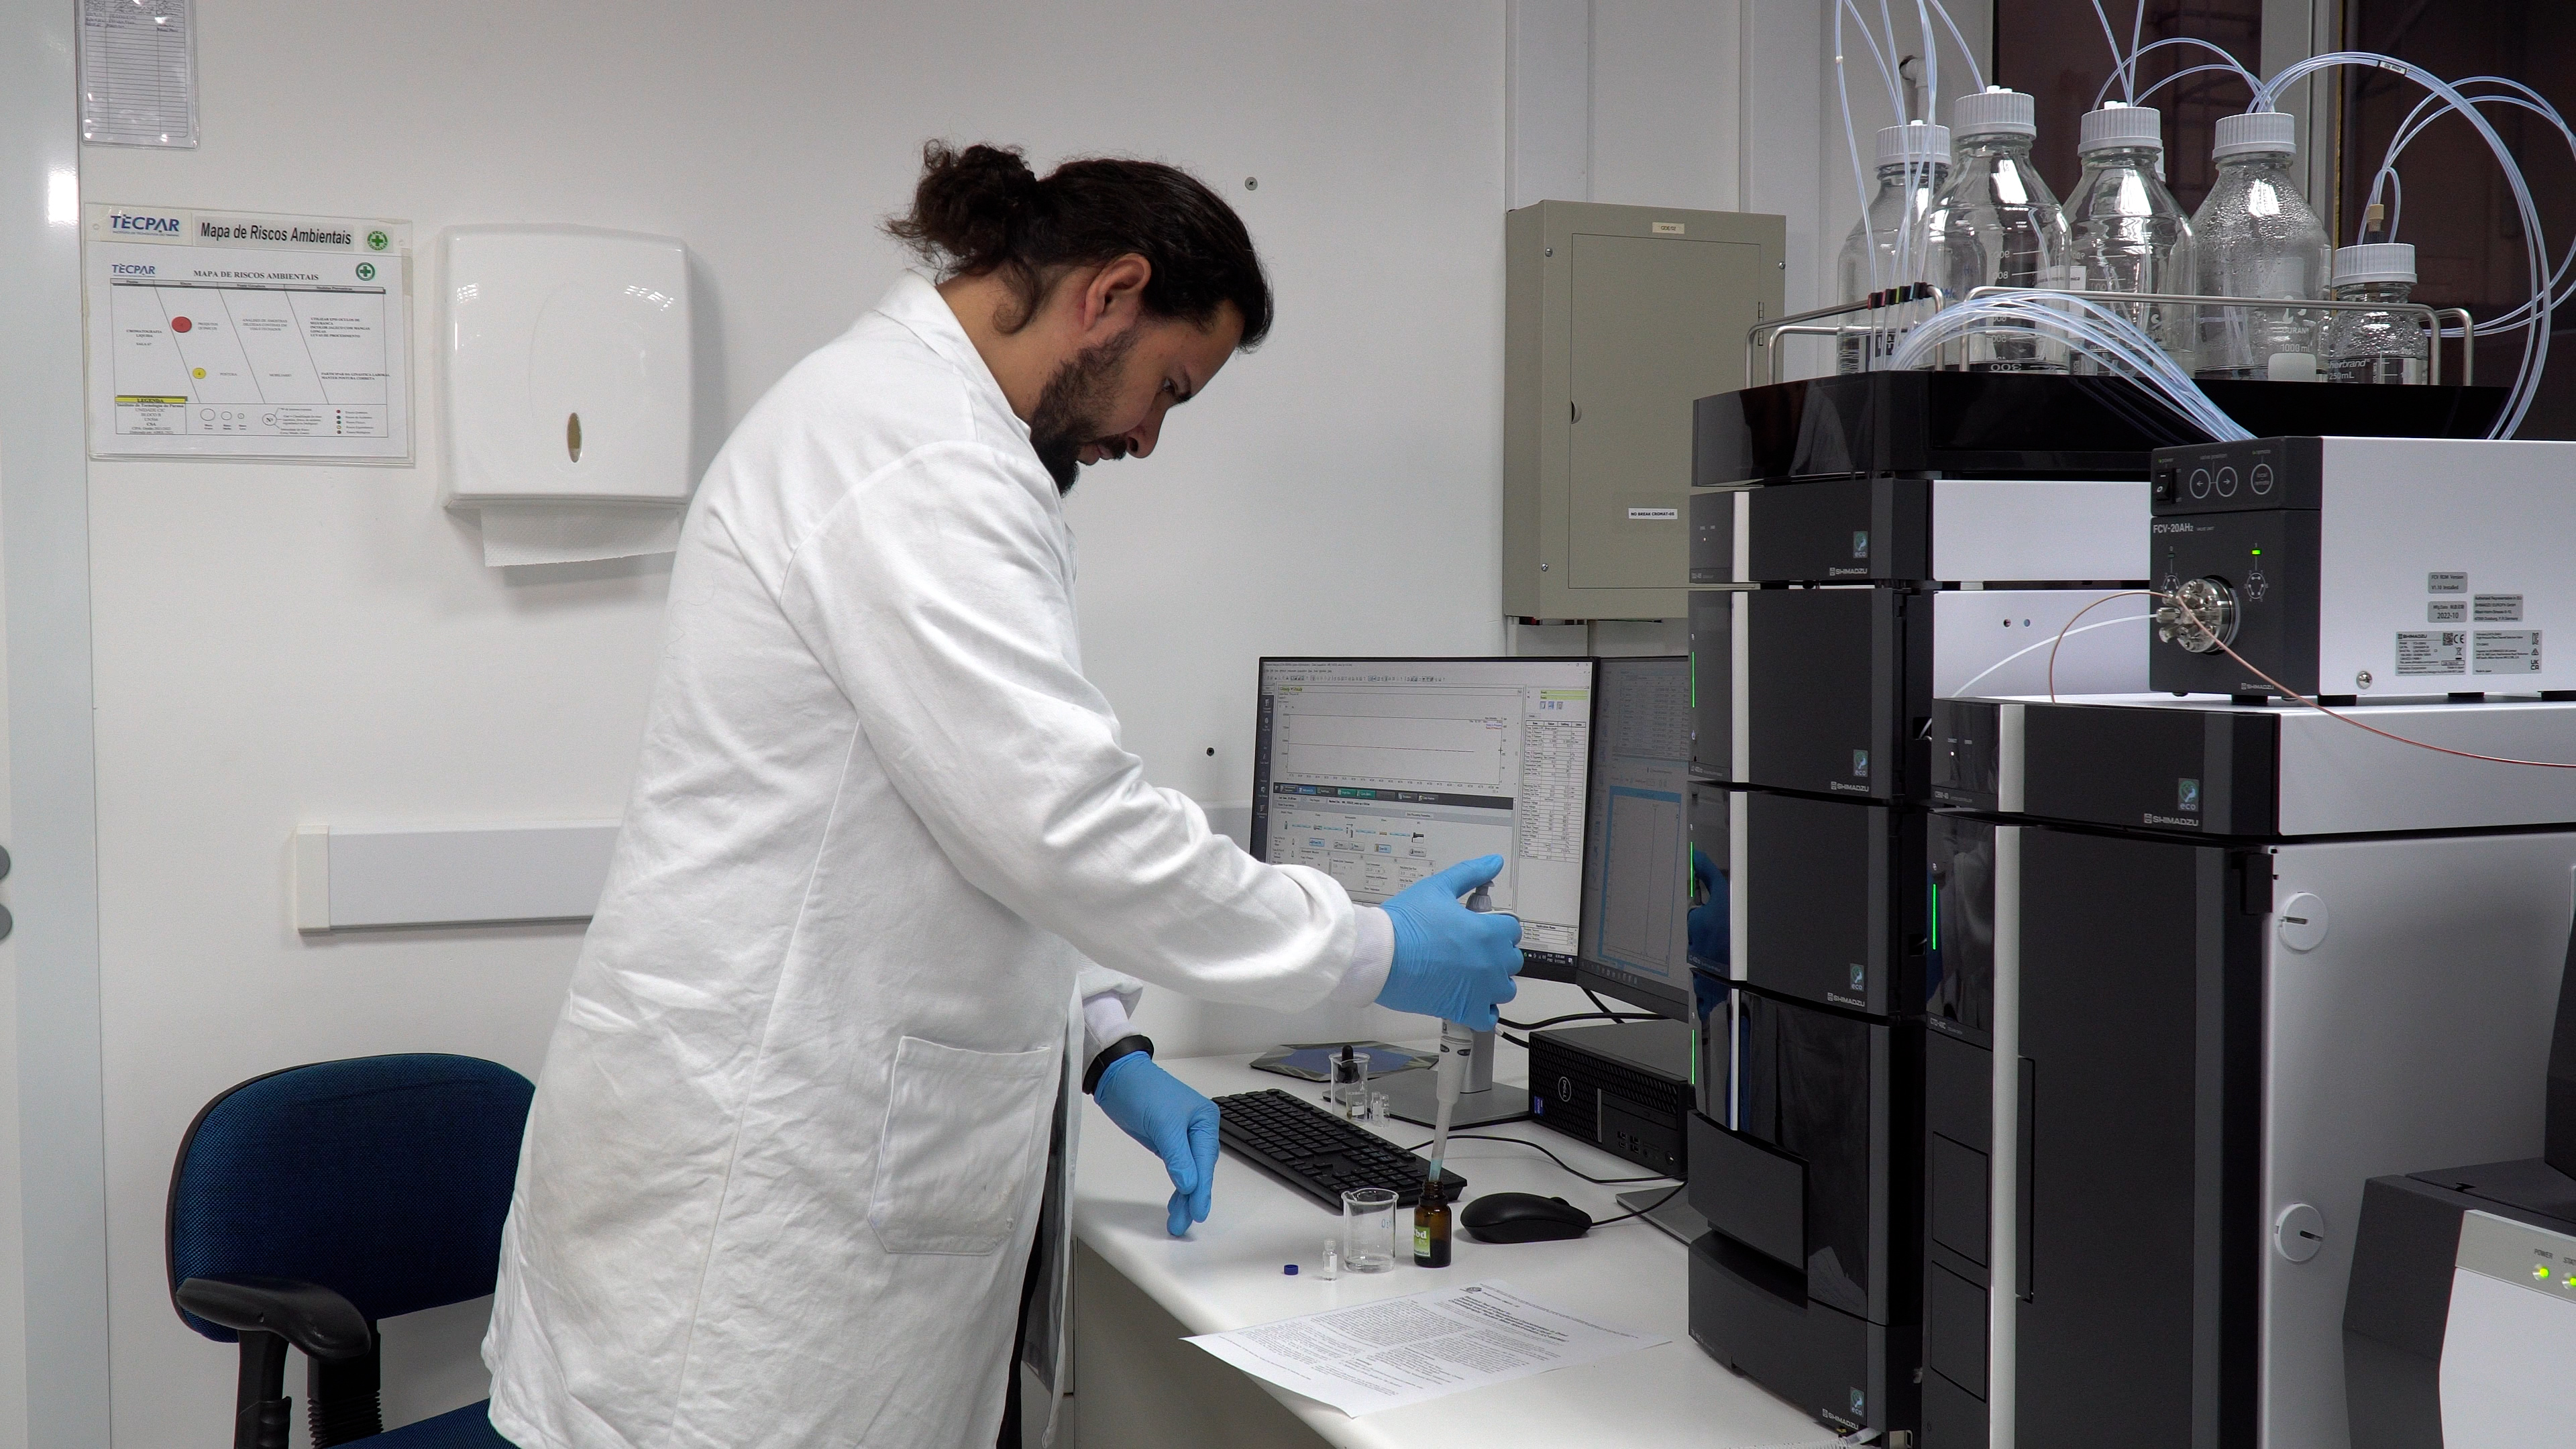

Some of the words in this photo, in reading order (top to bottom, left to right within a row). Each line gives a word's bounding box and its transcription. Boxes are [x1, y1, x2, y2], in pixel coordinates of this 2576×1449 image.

[201, 222, 230, 239] Mapa
[233, 224, 247, 238] de
[250, 225, 287, 241] Riscos
[290, 227, 352, 245] Ambientais
[193, 270, 218, 278] MAPA
[266, 272, 319, 282] AMBIENTAIS
[2281, 343, 2300, 352] 1000
[1837, 783, 1869, 792] SHIMADZU
[2180, 802, 2196, 810] eco
[2152, 816, 2198, 826] SHIMADZU
[1833, 995, 1865, 1006] SHIMADZU
[2534, 1248, 2553, 1259] POWER
[1829, 1413, 1860, 1430] SHIMADZU
